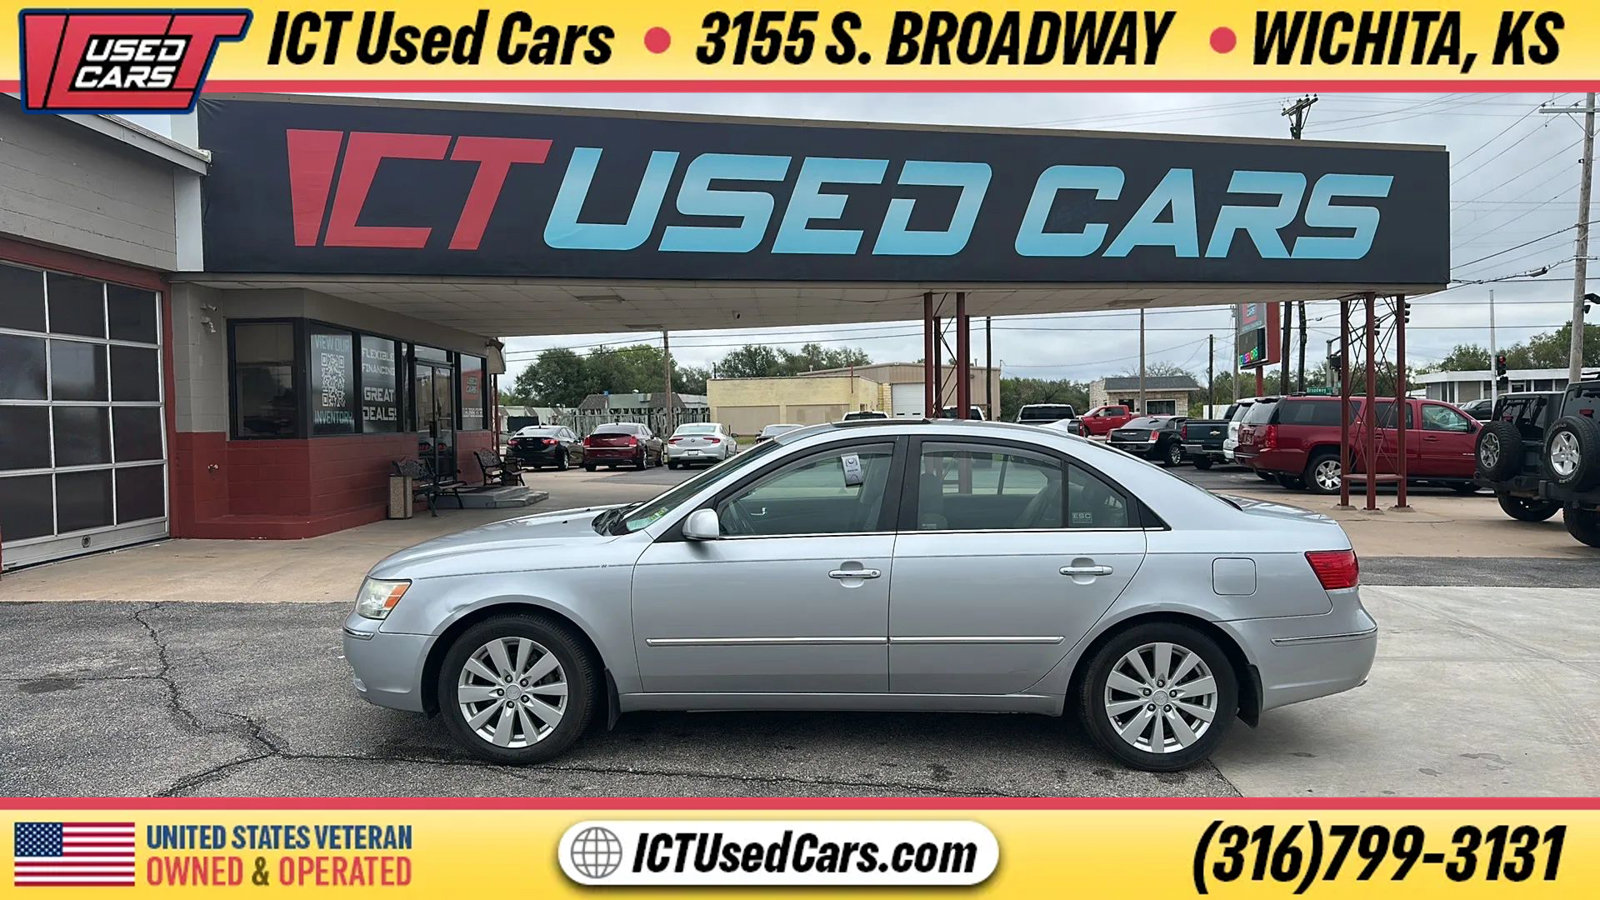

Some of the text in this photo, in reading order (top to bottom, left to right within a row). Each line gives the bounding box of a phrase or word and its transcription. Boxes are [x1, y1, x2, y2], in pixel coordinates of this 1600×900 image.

[286, 128, 1394, 260] ICT USED CARS
[314, 335, 333, 350] VIEW
[362, 348, 394, 362] FLEXIBLE
[362, 363, 395, 376] FINANCING
[364, 387, 394, 402] GREAT
[314, 410, 353, 425] INVENTORY
[363, 406, 397, 420] DEALS!
